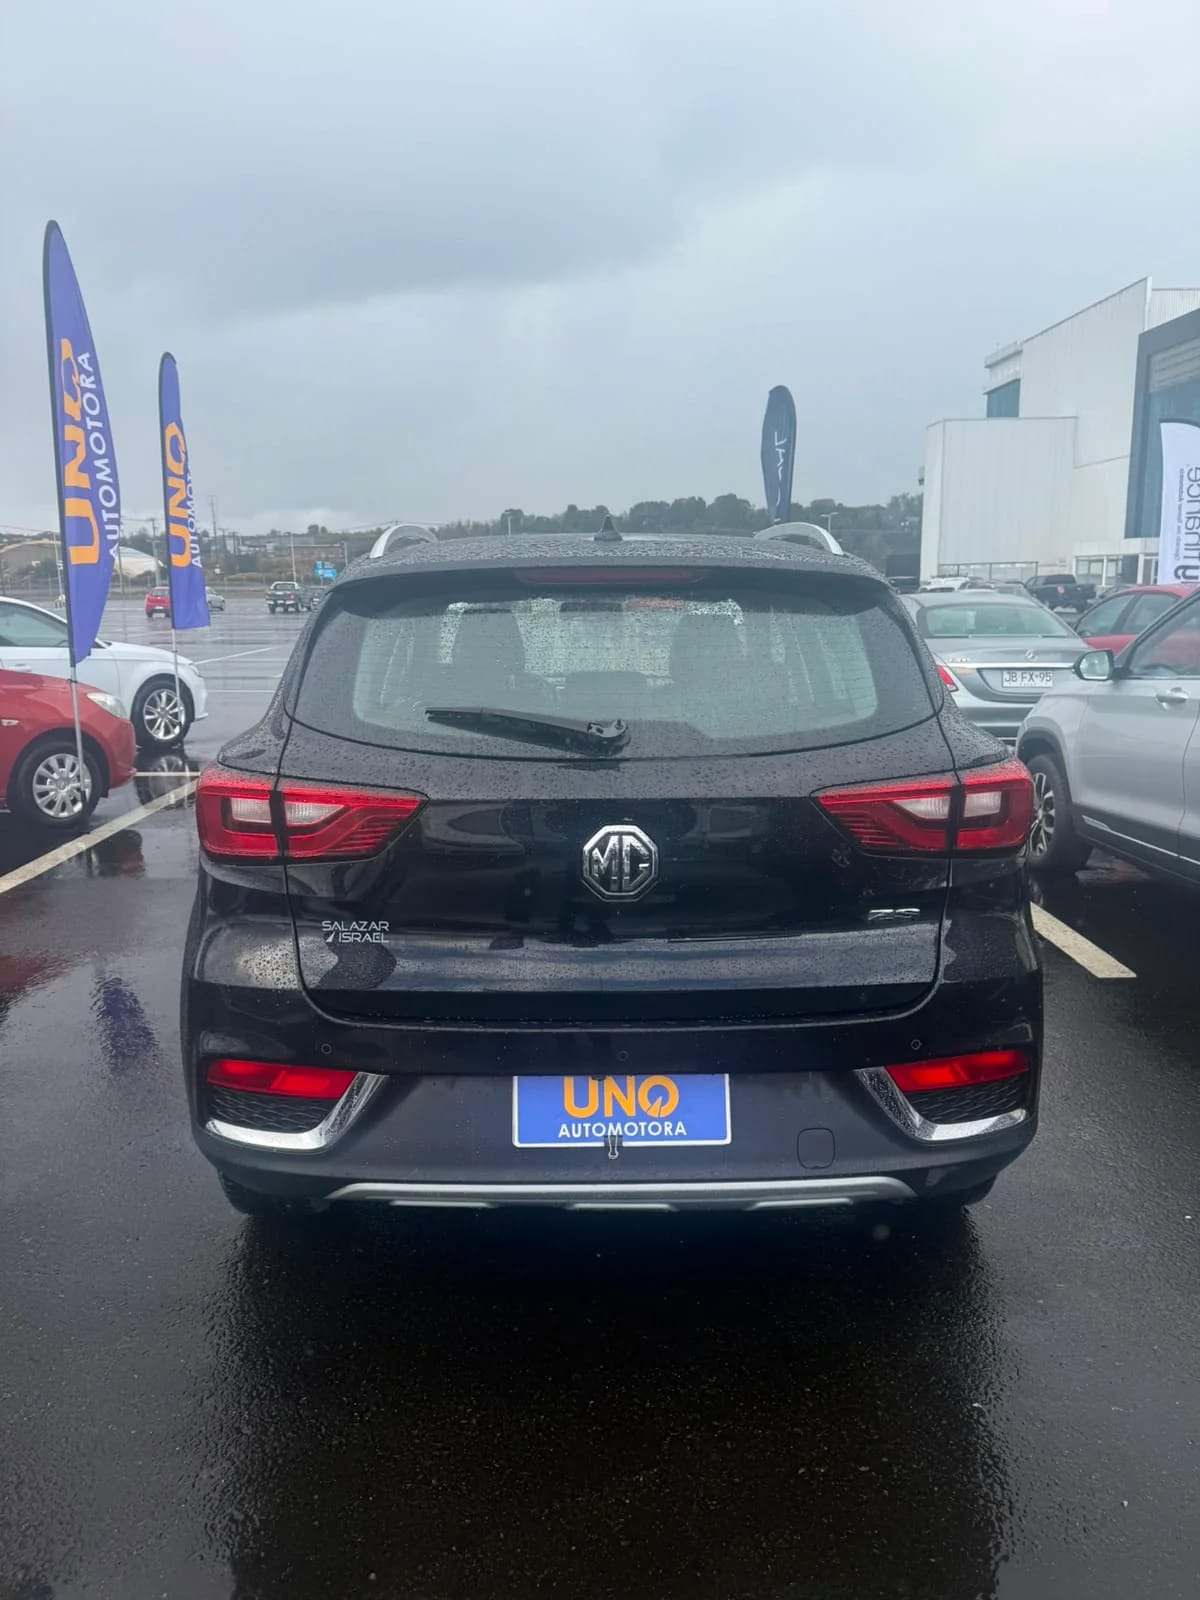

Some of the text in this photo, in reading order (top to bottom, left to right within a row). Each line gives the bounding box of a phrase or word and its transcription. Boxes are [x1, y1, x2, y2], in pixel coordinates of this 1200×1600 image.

[78, 352, 120, 561] AUTOMOTORA
[165, 422, 191, 568] UNO
[591, 835, 650, 892] MG
[321, 920, 389, 931] SALAZAR
[338, 932, 390, 943] ISRAEL
[563, 1075, 679, 1119] UNO
[558, 1121, 687, 1139] AUTOMOTORA
